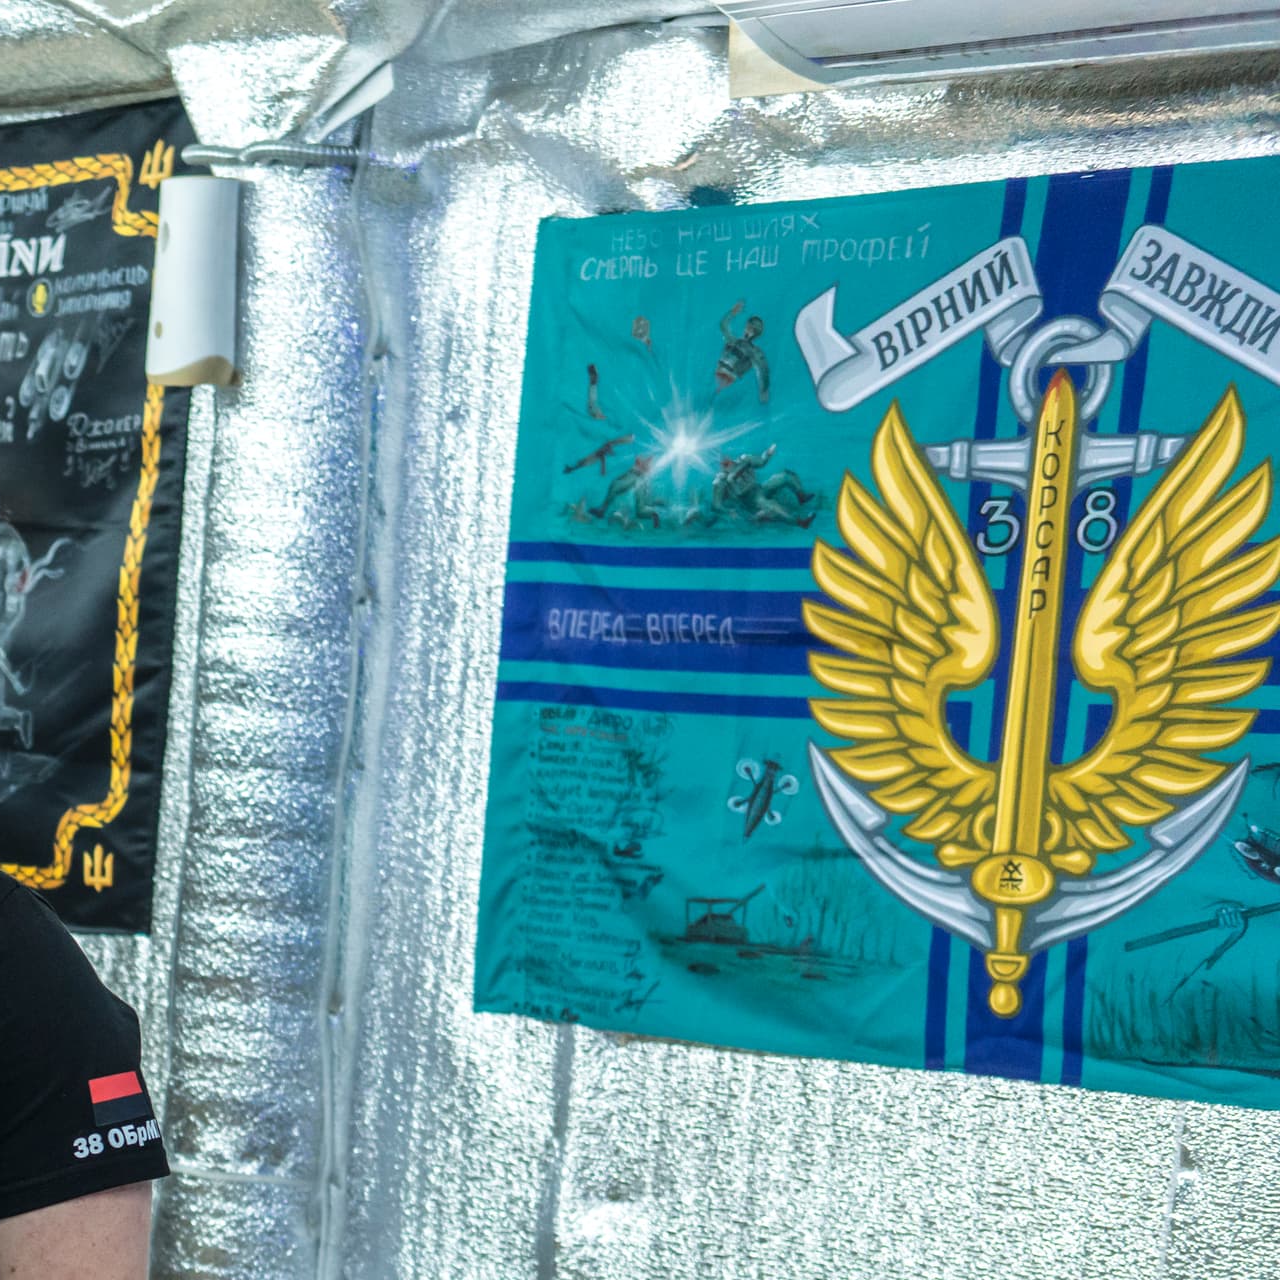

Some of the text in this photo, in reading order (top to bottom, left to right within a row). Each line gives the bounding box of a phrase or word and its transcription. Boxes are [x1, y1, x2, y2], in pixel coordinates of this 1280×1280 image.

[871, 238, 1280, 372] ВІРНИЙ ЗАВЖДИ
[646, 613, 736, 648] ВПЕРЕД
[72, 1132, 104, 1159] 38
